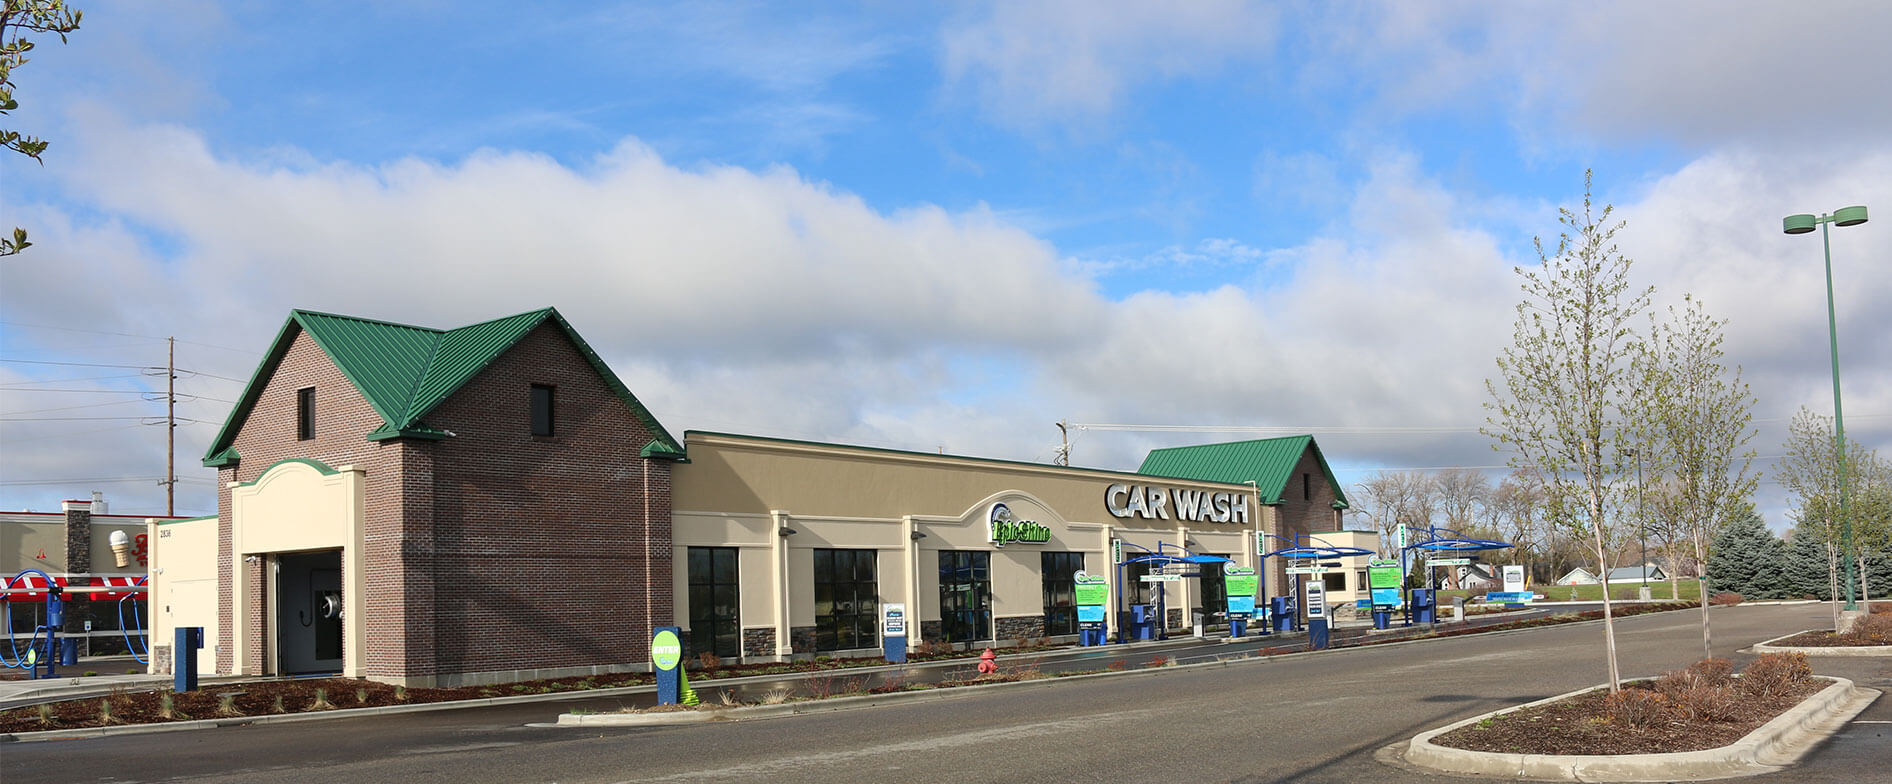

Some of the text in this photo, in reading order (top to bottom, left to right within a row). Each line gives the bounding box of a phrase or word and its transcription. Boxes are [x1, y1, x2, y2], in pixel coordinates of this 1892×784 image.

[1105, 483, 1249, 524] CAR WASH
[653, 645, 679, 654] ENTER
